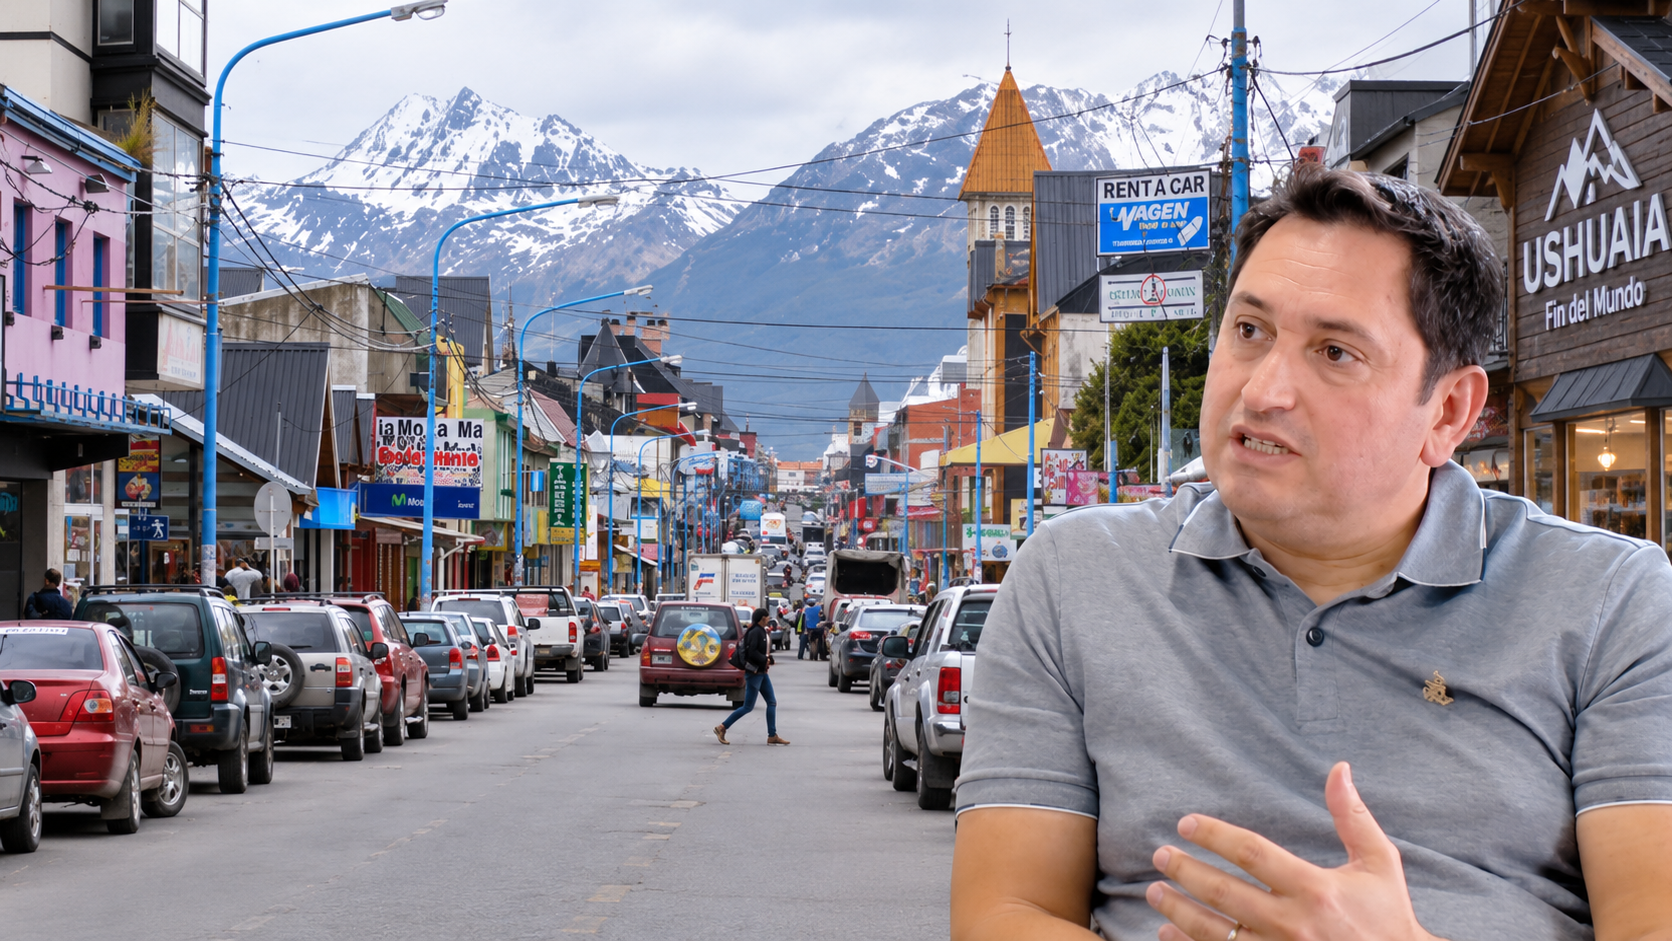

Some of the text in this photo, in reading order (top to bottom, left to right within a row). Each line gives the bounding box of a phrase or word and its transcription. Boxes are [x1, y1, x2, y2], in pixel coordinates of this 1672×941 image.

[1104, 176, 1204, 198] RENT A CAR
[1523, 193, 1671, 294] USHUAIA
[1545, 276, 1646, 331] Fin del Mundo
[458, 421, 482, 438] Ma
